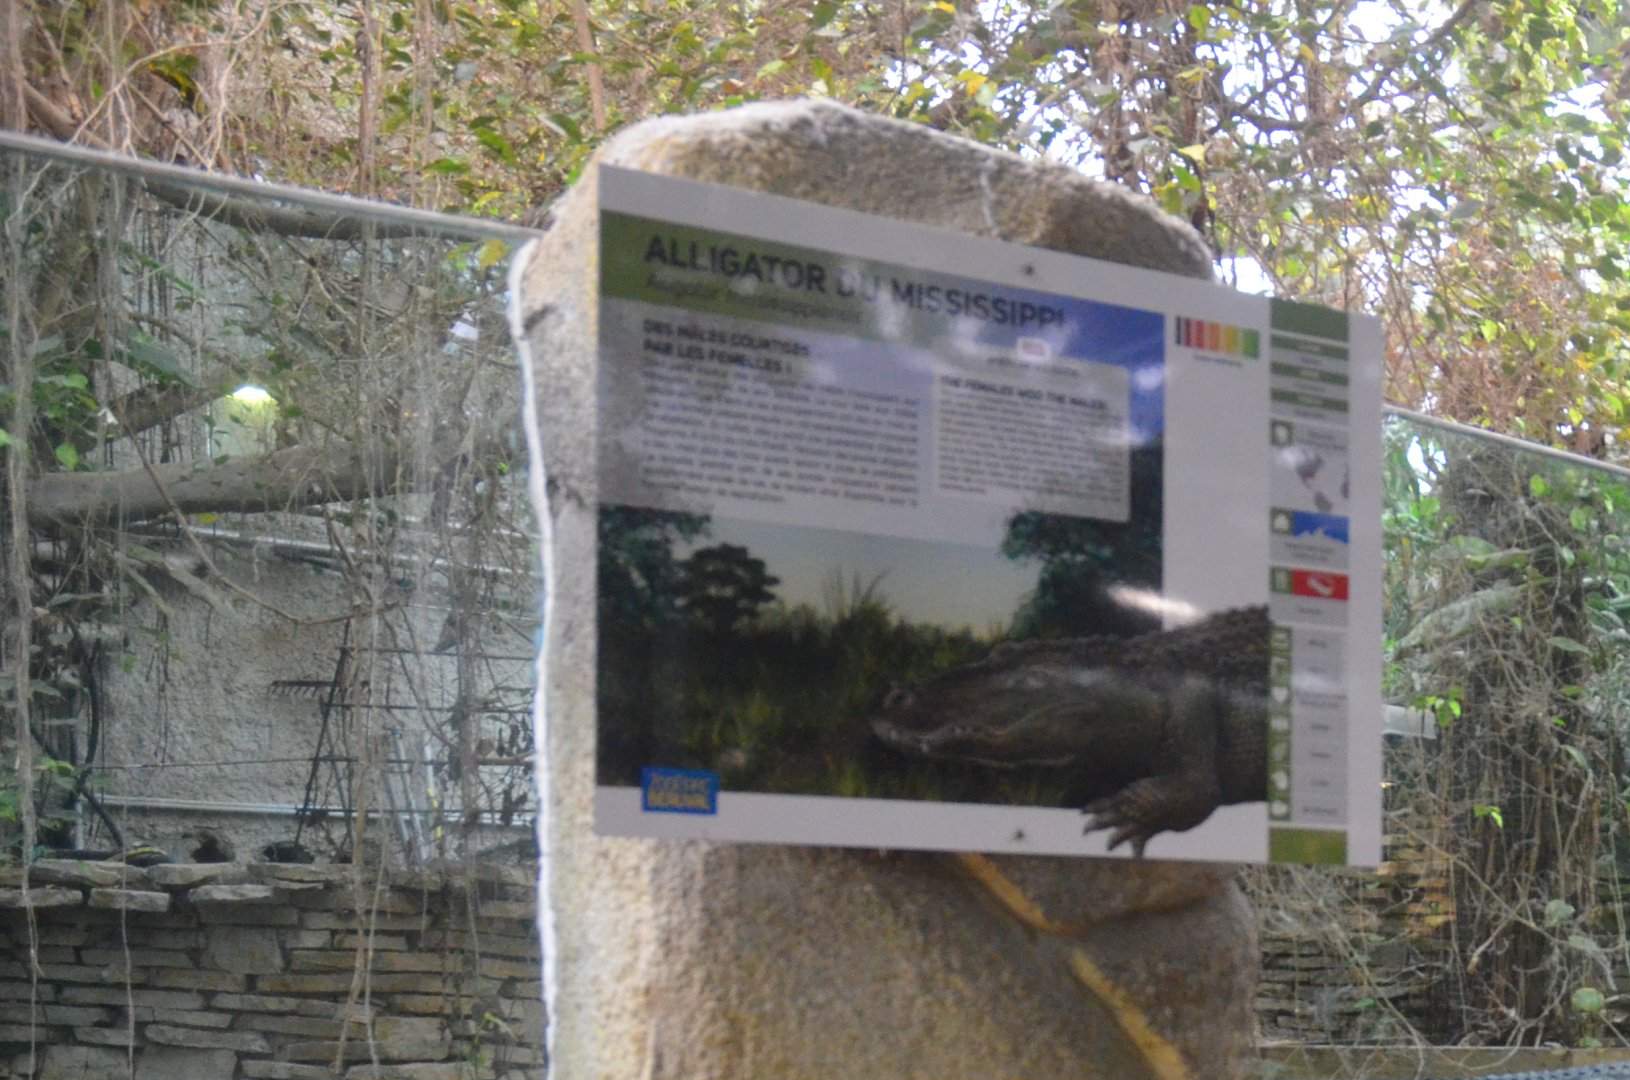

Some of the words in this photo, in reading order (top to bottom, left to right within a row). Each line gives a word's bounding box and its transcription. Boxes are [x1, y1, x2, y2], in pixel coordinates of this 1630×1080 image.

[644, 235, 826, 293] ALLIGATOR
[837, 266, 882, 302] DU
[892, 278, 1065, 327] MISSISSIPPI
